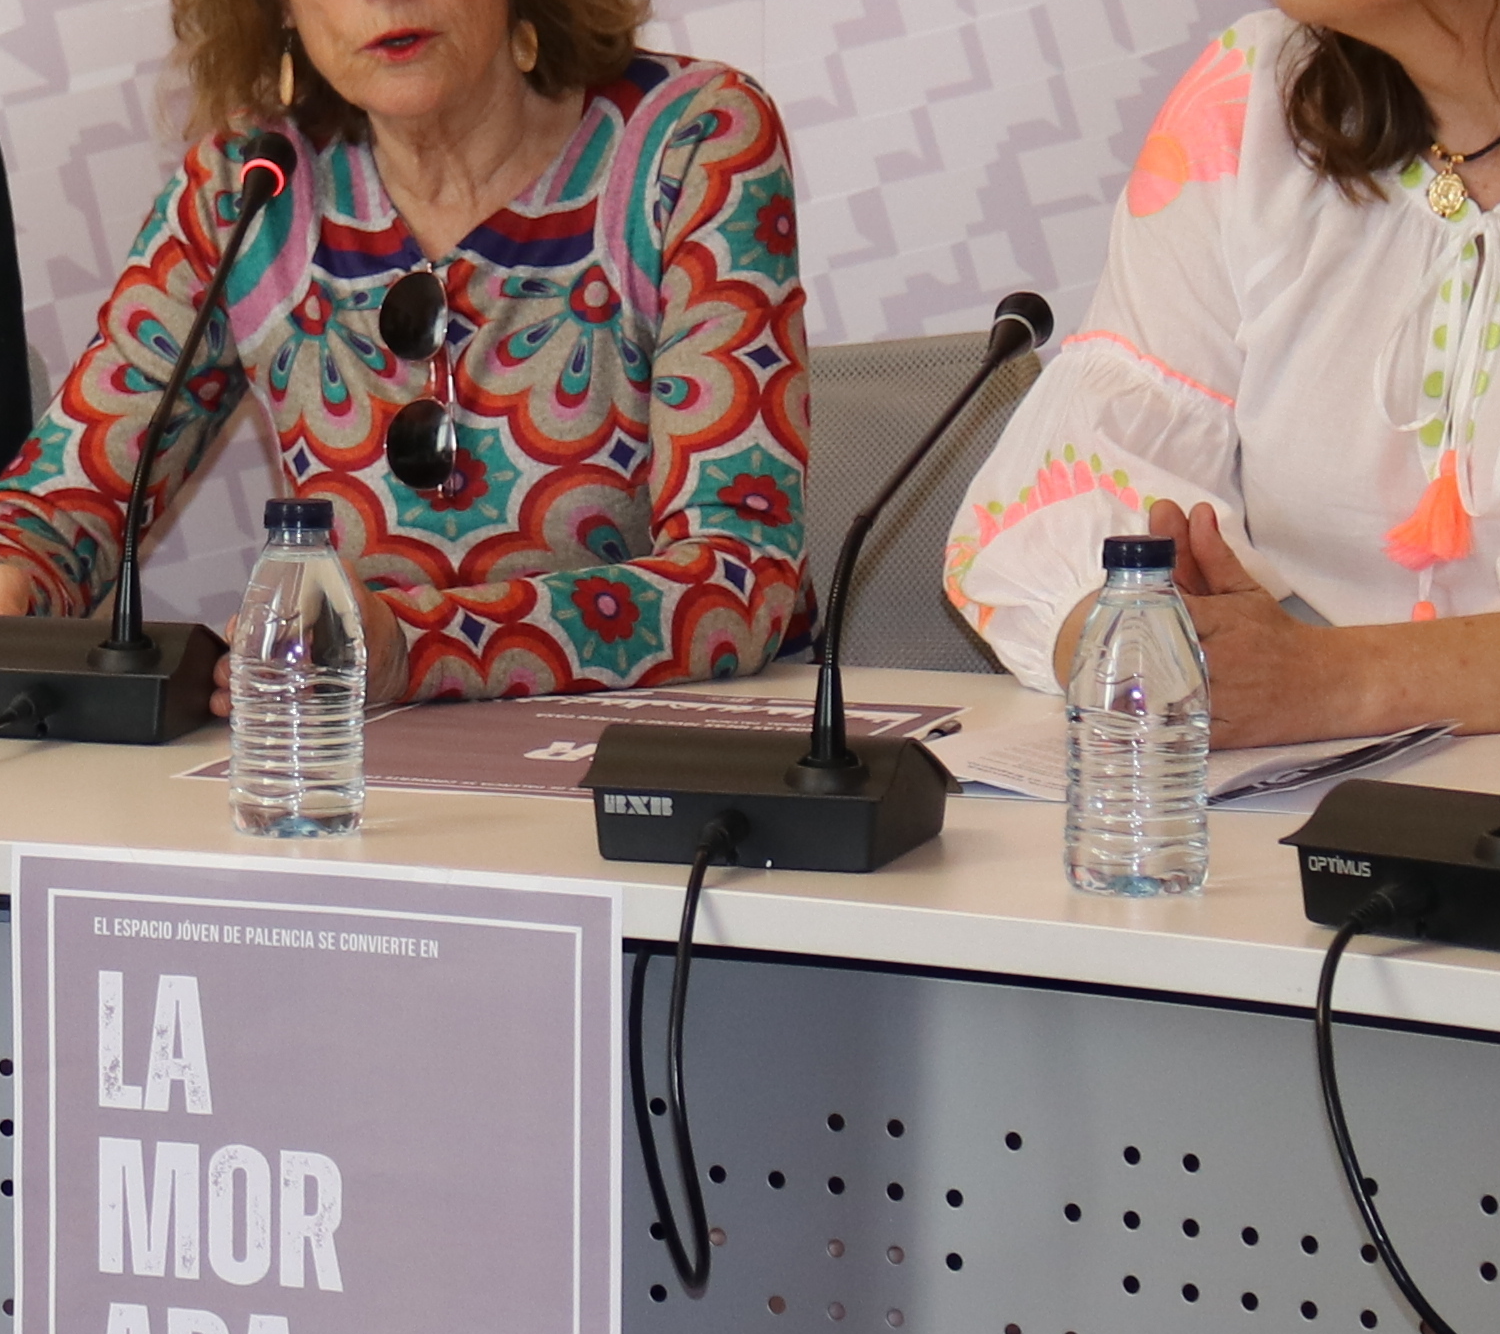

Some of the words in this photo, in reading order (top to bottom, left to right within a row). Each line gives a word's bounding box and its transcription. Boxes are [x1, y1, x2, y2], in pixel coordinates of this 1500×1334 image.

[604, 794, 673, 816] BXB
[1308, 856, 1371, 877] OPTIMUS
[94, 917, 111, 936] EL
[114, 918, 172, 939] ESPACIO
[175, 920, 219, 943] JÓVEN
[223, 925, 241, 944] DE
[246, 927, 314, 949] PALENCIA
[318, 932, 336, 951] SE
[340, 933, 416, 957] CONVIERTE
[420, 939, 439, 959] EN
[98, 969, 213, 1116] LA
[98, 1137, 345, 1292] MOR
